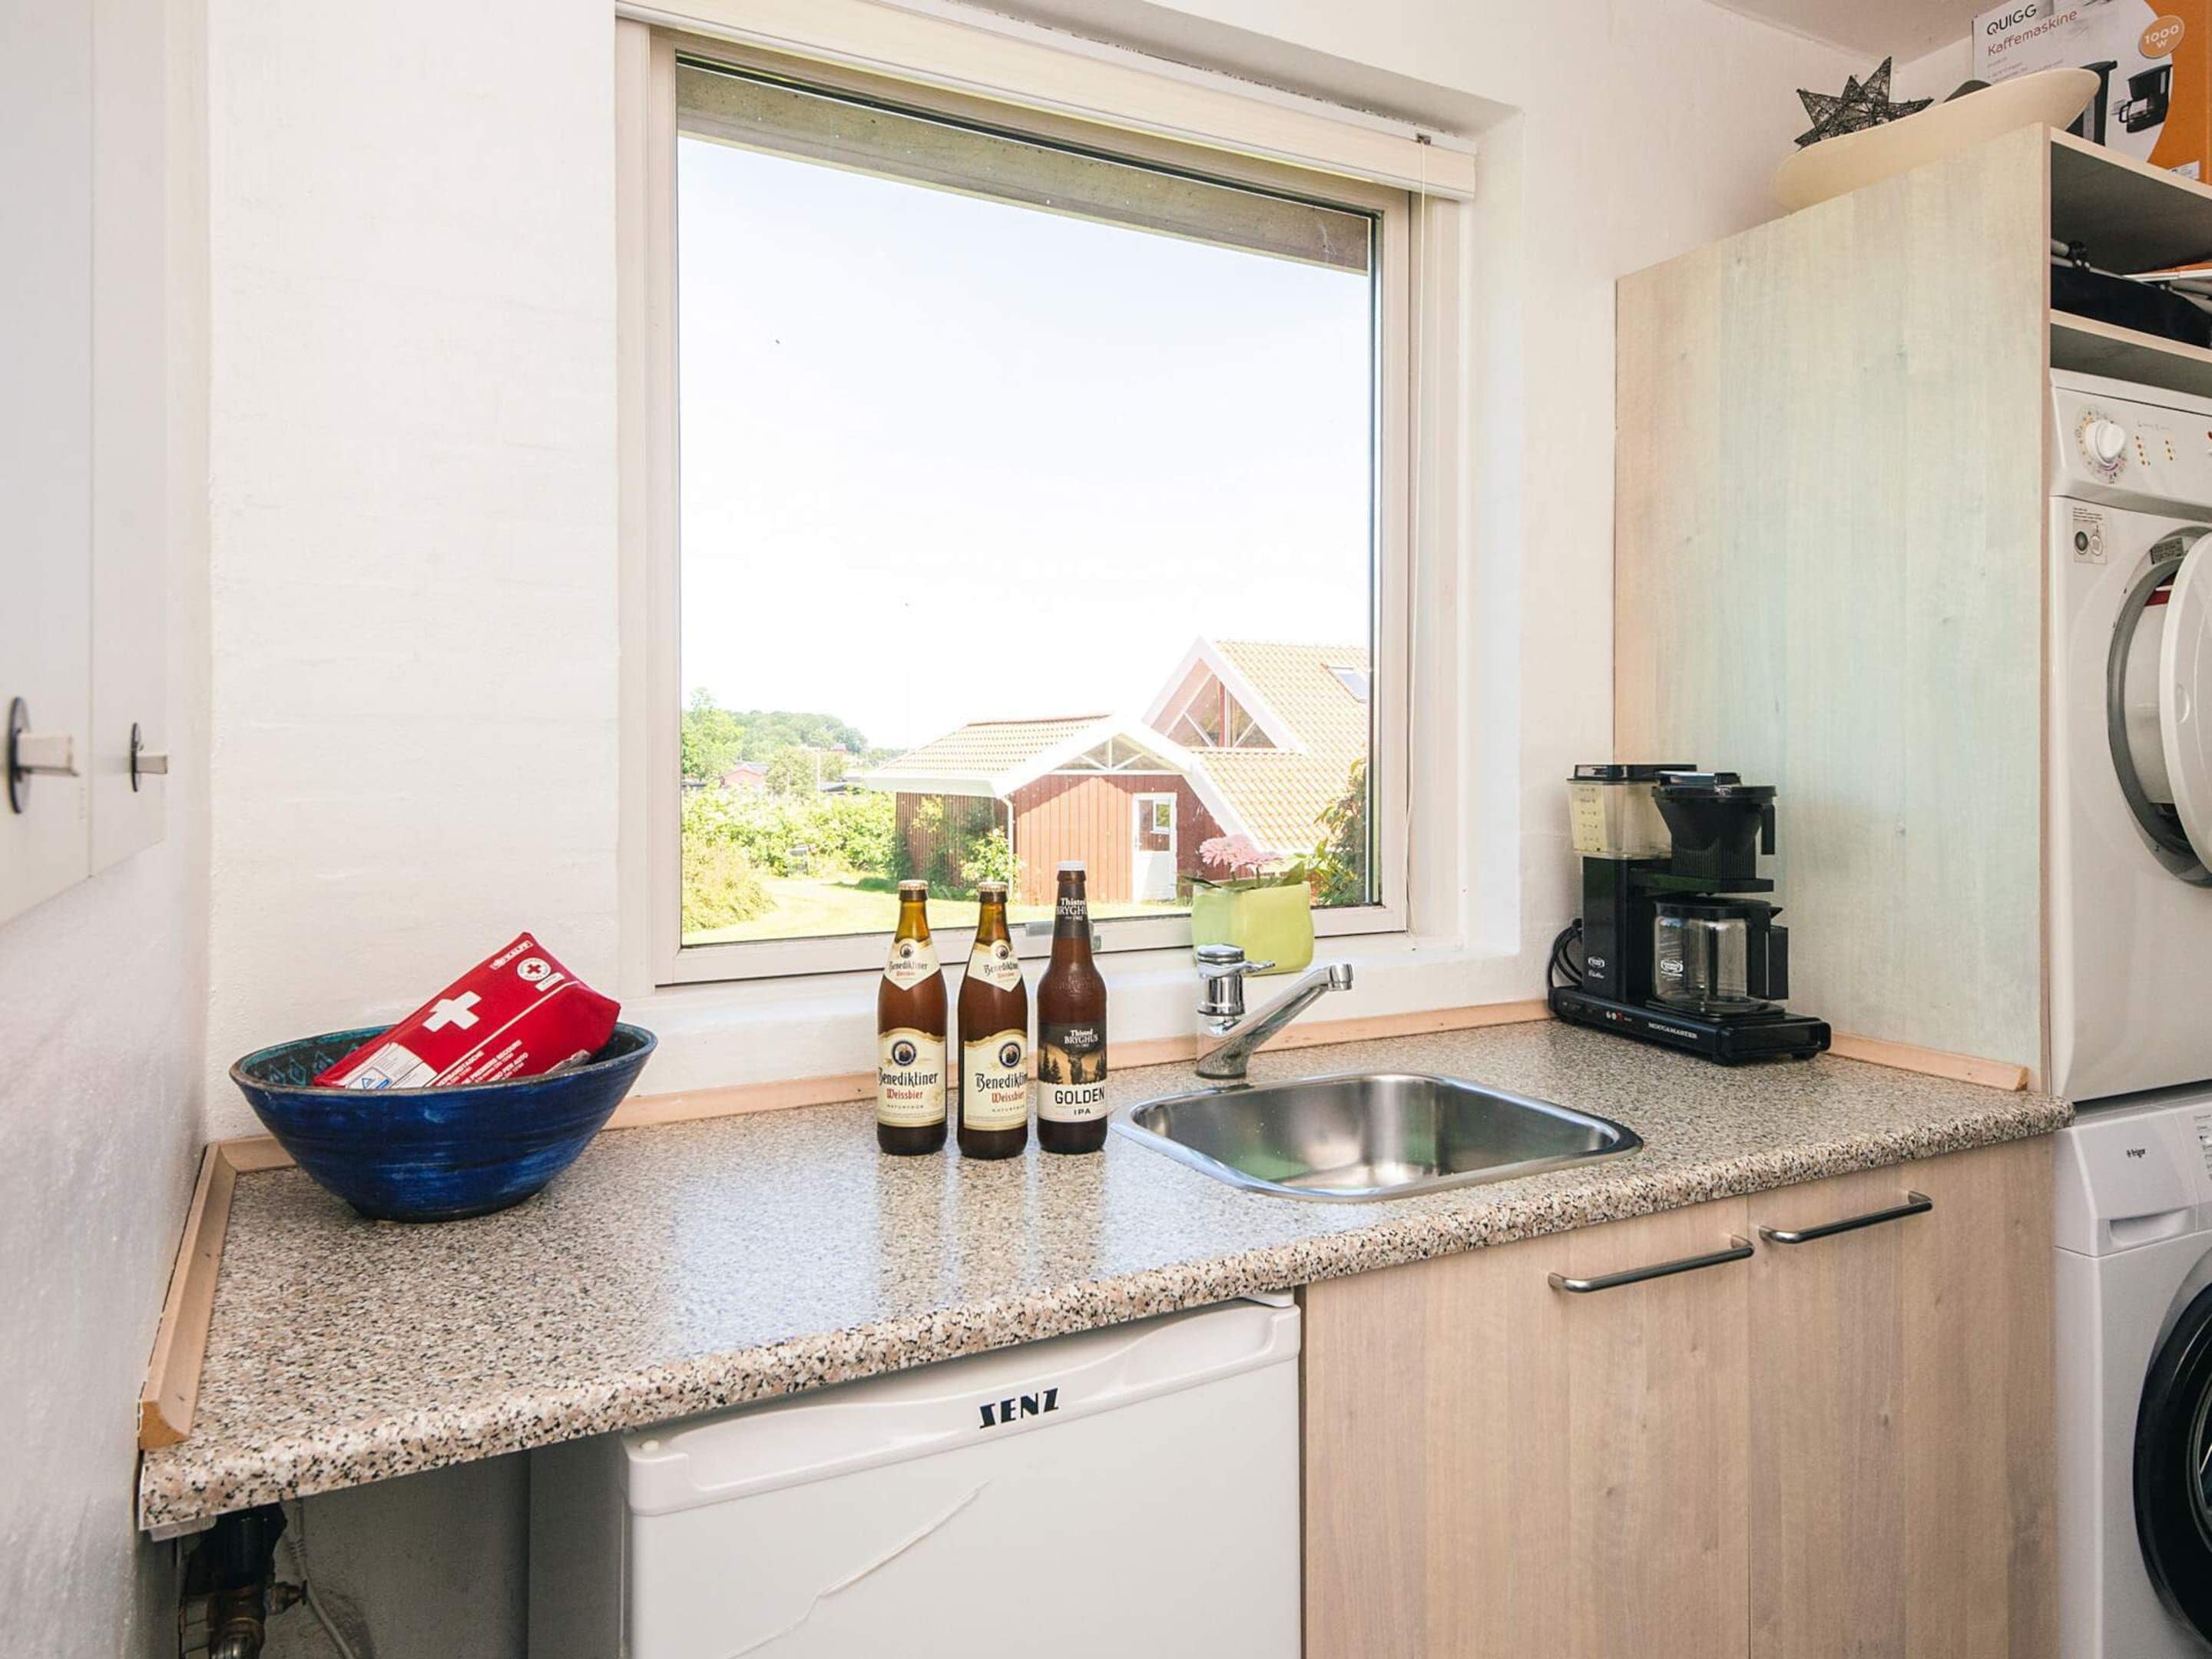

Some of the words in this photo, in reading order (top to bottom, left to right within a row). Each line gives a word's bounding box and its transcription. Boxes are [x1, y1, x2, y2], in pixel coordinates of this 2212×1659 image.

[1987, 4, 2036, 35] QUIGG
[1988, 10, 2077, 56] Kaffemaskine
[2144, 25, 2179, 44] 1000
[2157, 39, 2167, 48] W
[1064, 1034, 1099, 1045] BRYGHUS
[513, 1051, 528, 1065] AUTO
[886, 1088, 923, 1100] Weissbier
[992, 1091, 1025, 1104] Weissbier
[1055, 1086, 1104, 1104] GOLDEN
[979, 1387, 1059, 1429] SENZ
